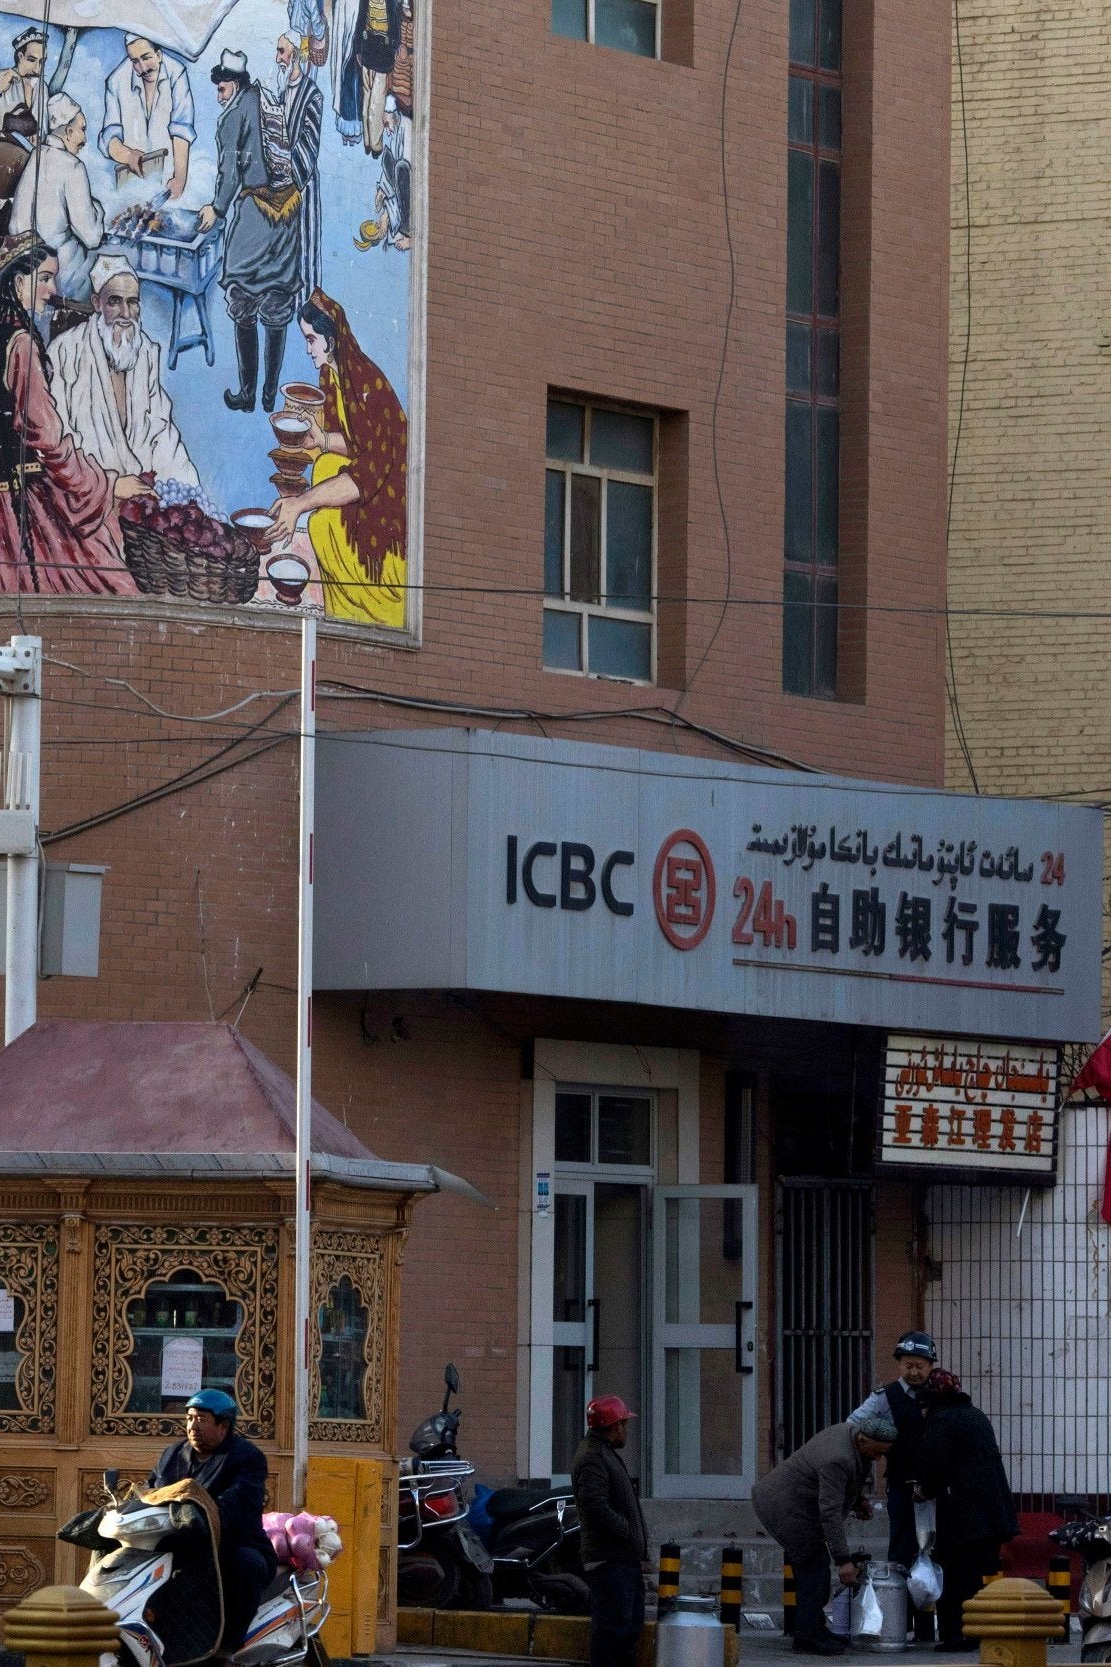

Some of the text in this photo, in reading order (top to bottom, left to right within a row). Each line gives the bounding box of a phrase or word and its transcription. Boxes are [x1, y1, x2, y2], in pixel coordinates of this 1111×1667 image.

[506, 834, 635, 916] ICBC
[1041, 851, 1067, 886] 24
[732, 876, 1068, 974] 24h 自助银行服务
